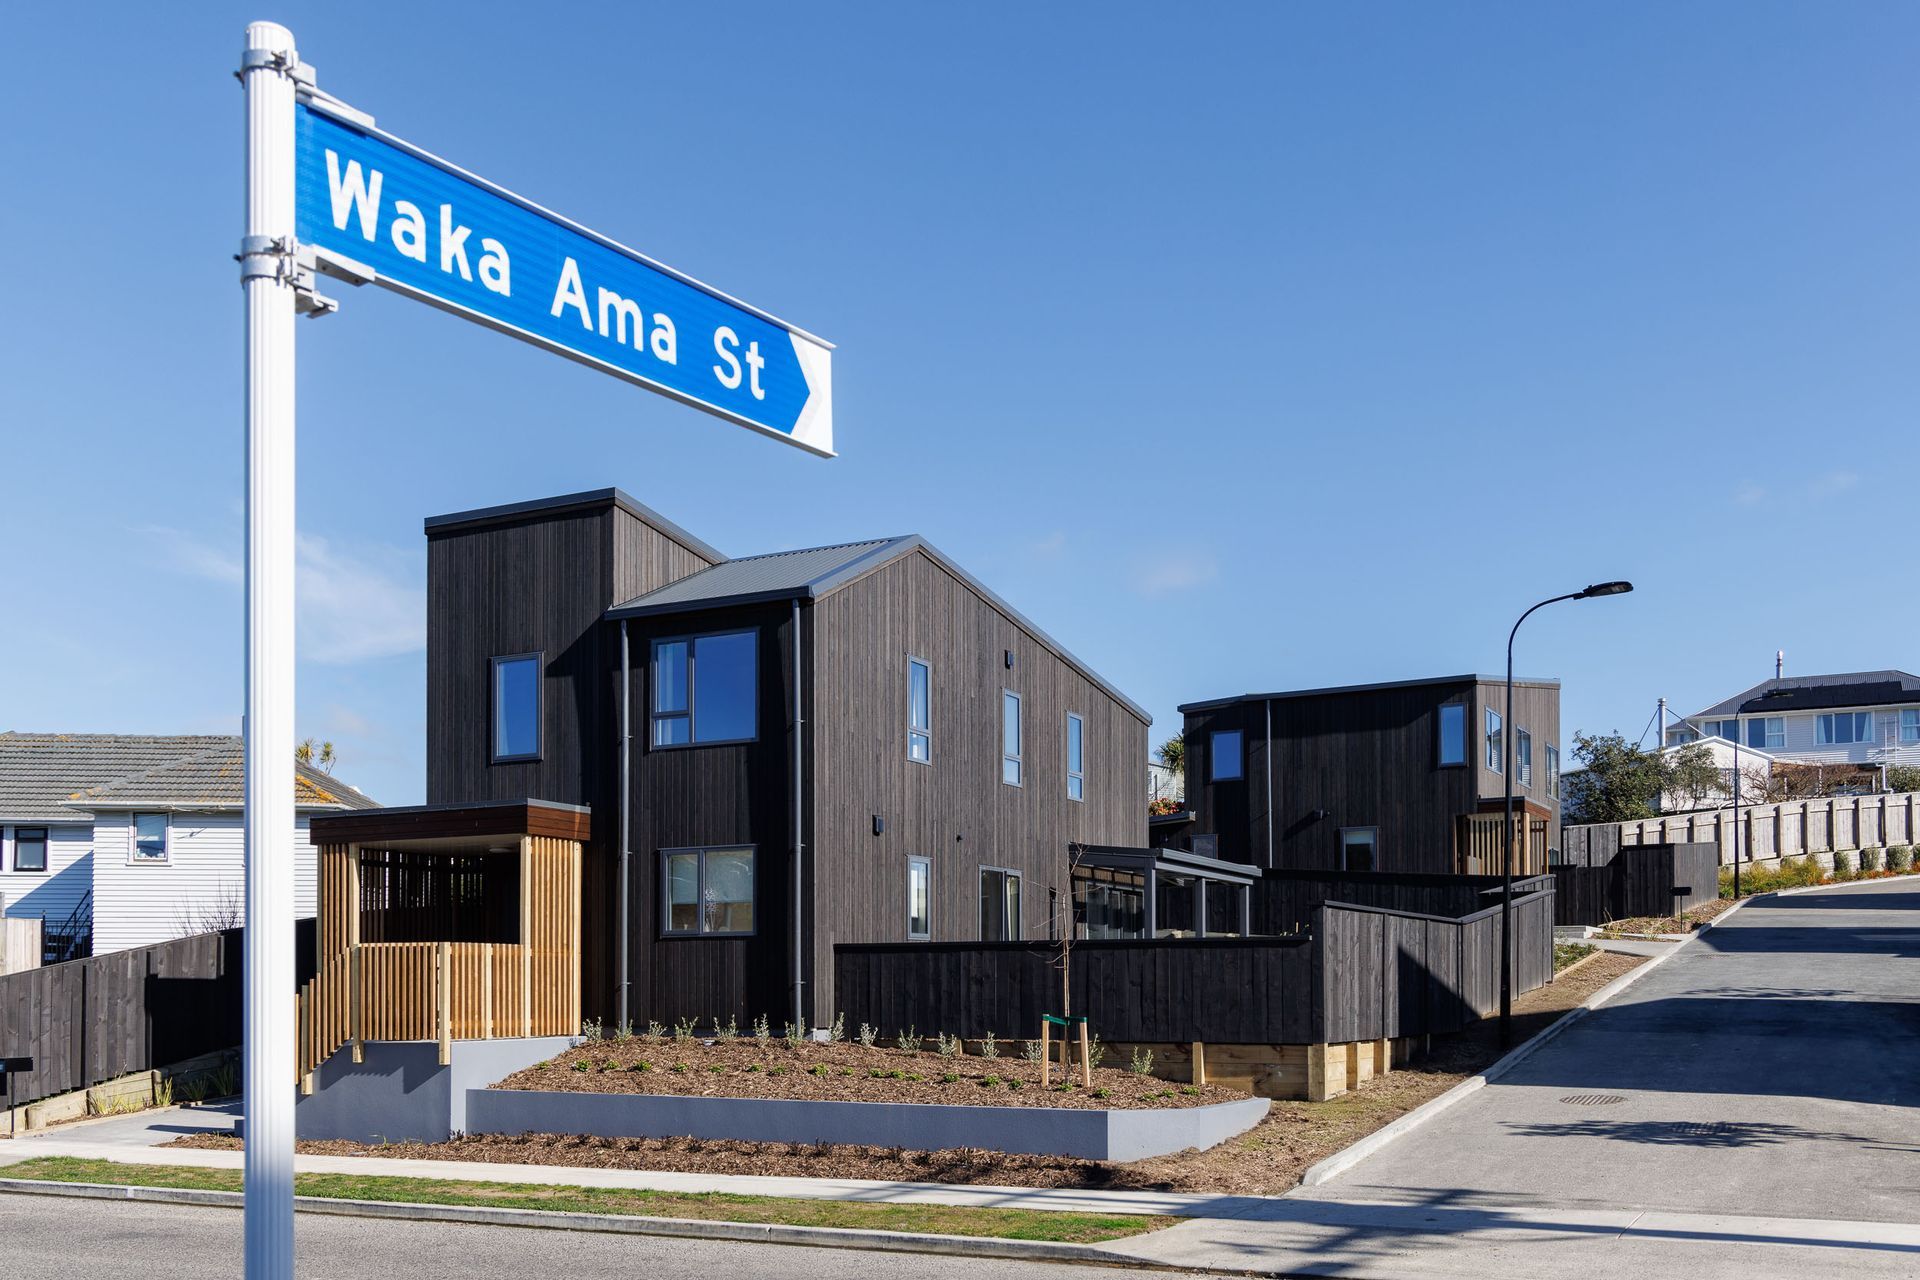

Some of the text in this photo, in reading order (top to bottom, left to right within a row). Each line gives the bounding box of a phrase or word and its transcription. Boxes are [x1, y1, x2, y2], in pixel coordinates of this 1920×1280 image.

[325, 148, 766, 401] Waka Ama St
